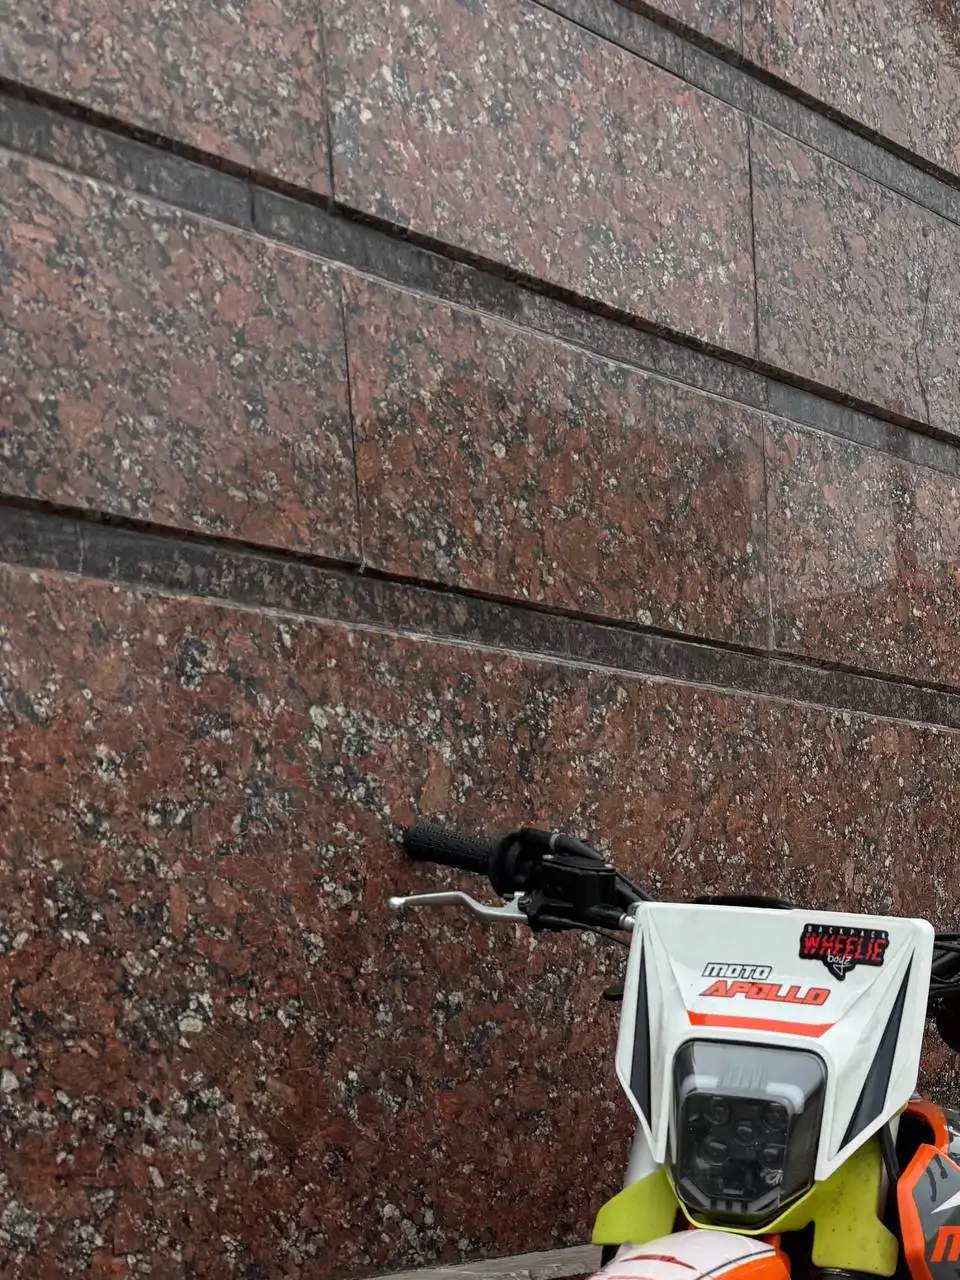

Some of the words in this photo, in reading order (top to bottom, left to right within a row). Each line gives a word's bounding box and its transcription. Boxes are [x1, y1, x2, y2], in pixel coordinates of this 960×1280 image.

[807, 925, 886, 939] BACKPACK
[802, 934, 887, 961] WHEELIE
[701, 962, 772, 980] MOTO
[698, 979, 831, 1006] APOLLO
